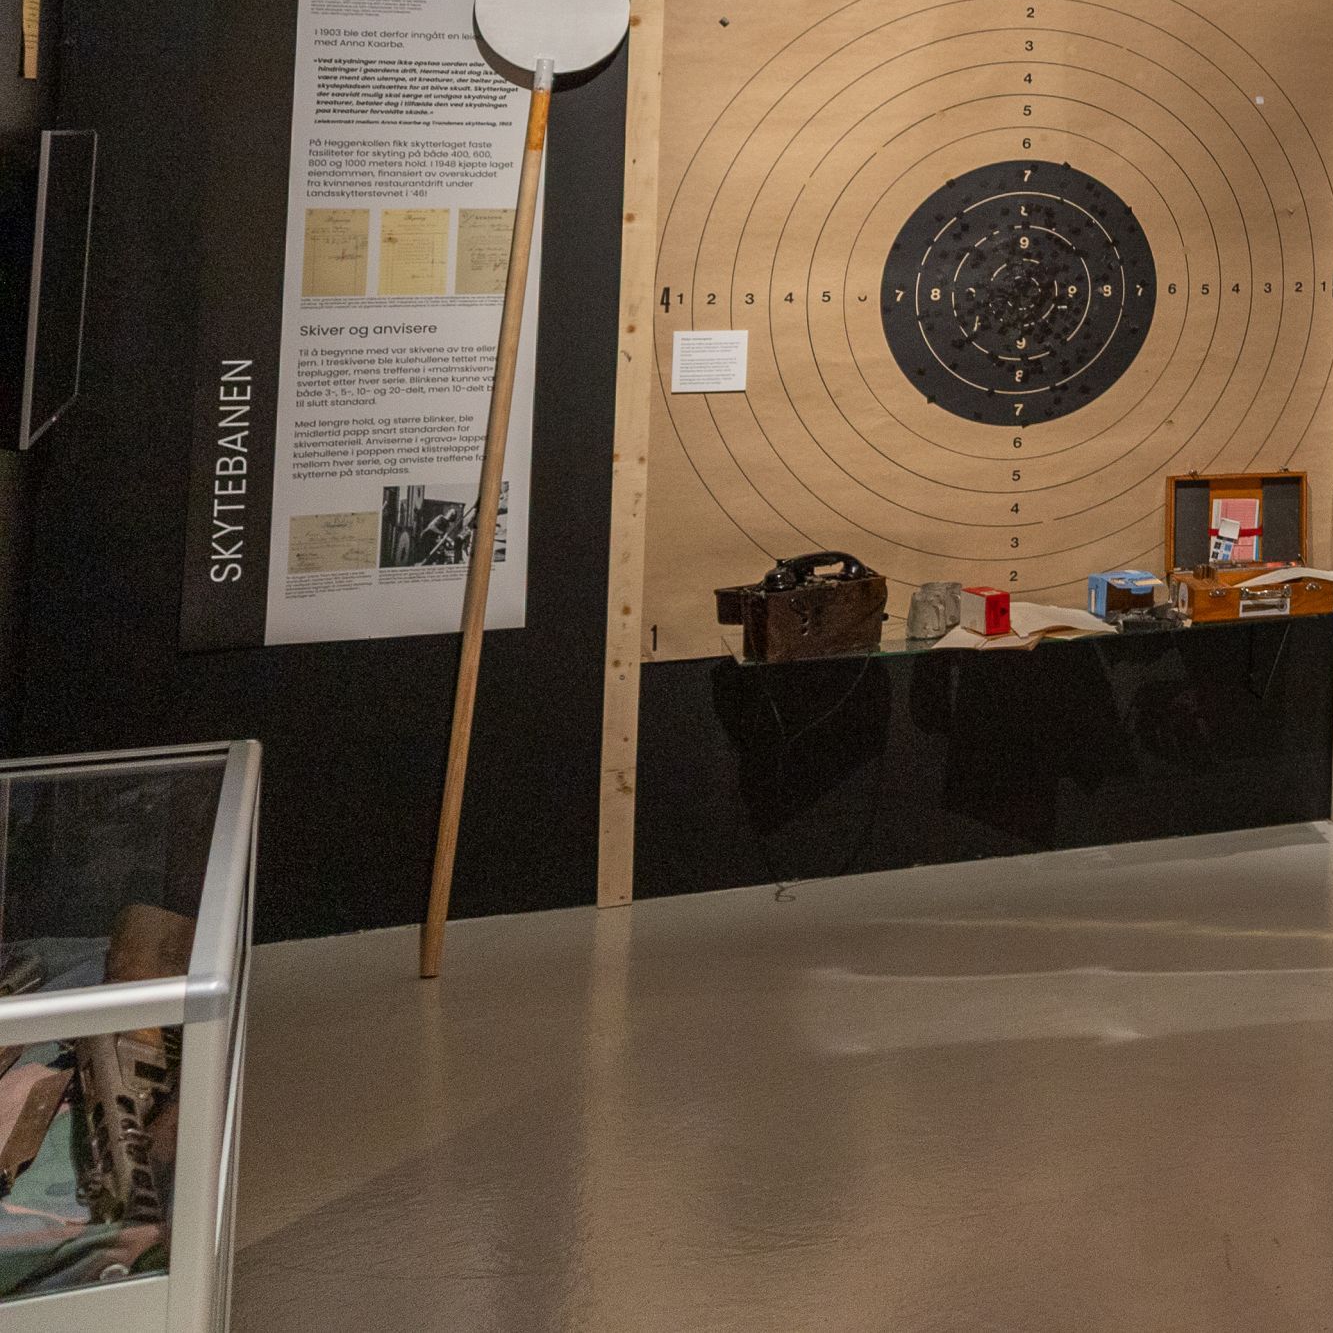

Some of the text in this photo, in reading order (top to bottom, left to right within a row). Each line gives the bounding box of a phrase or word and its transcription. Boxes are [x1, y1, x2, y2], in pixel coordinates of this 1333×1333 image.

[324, 139, 390, 148] Heggenkollen
[410, 140, 466, 149] skytterlaget
[372, 150, 405, 159] skyting
[408, 149, 421, 159] på
[308, 158, 326, 166] 800
[458, 160, 487, 170] kjøpte
[489, 160, 513, 170] laget
[1167, 283, 1177, 295] 6
[1201, 283, 1210, 296] 5
[1231, 283, 1241, 294] 4
[1263, 282, 1272, 294] 3
[1294, 281, 1303, 293] 2
[1321, 281, 1326, 292] 1
[660, 286, 717, 314] 4 1 2
[300, 324, 437, 337] Skiver og anvisere
[210, 359, 253, 583] SKYTEBANEN
[650, 624, 658, 652] 1
